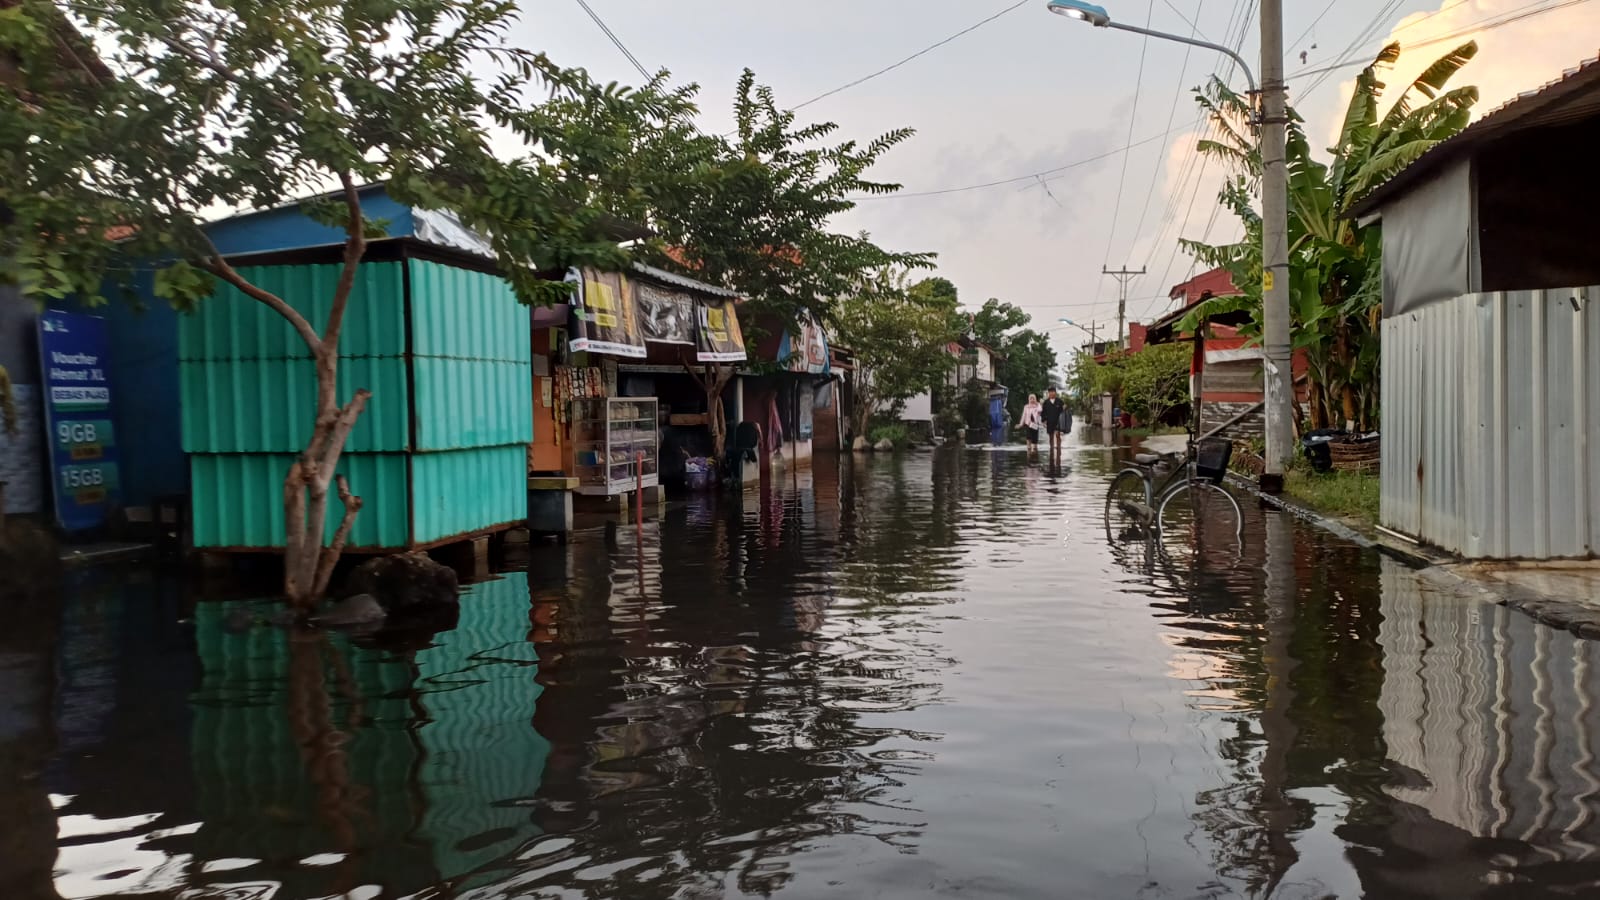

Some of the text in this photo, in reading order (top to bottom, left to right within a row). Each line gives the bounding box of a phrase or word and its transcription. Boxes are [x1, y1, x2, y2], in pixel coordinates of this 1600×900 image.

[51, 351, 98, 365] Voucher
[50, 368, 106, 381] Hemat XL
[58, 423, 97, 443] 9GB
[61, 468, 103, 487] 15GB
